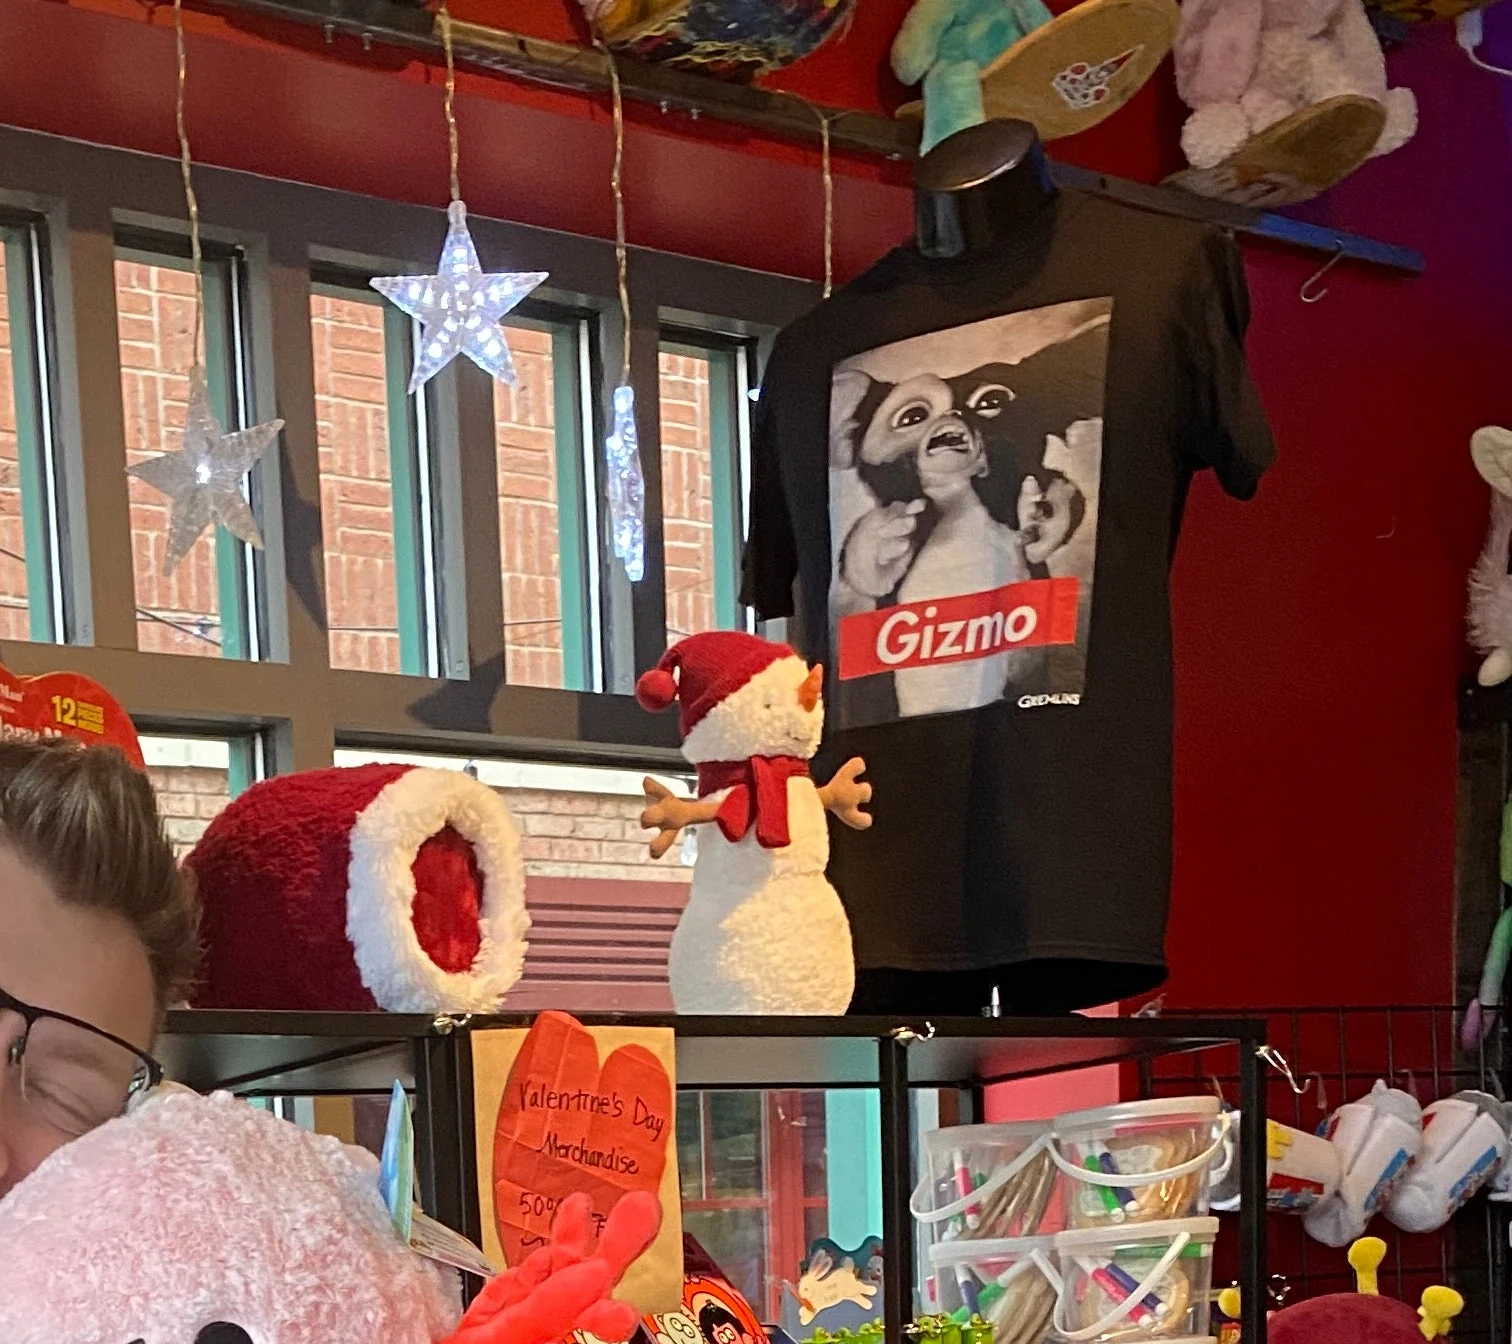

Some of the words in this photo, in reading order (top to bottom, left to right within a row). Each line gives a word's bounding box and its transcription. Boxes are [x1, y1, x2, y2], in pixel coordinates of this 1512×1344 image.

[876, 605, 1038, 665] Gizmo
[51, 695, 77, 727] 12
[1016, 693, 1081, 709] GREMLINS
[519, 1080, 624, 1118] Valentine's
[632, 1095, 666, 1143] Day
[535, 1131, 640, 1175] Merchandise
